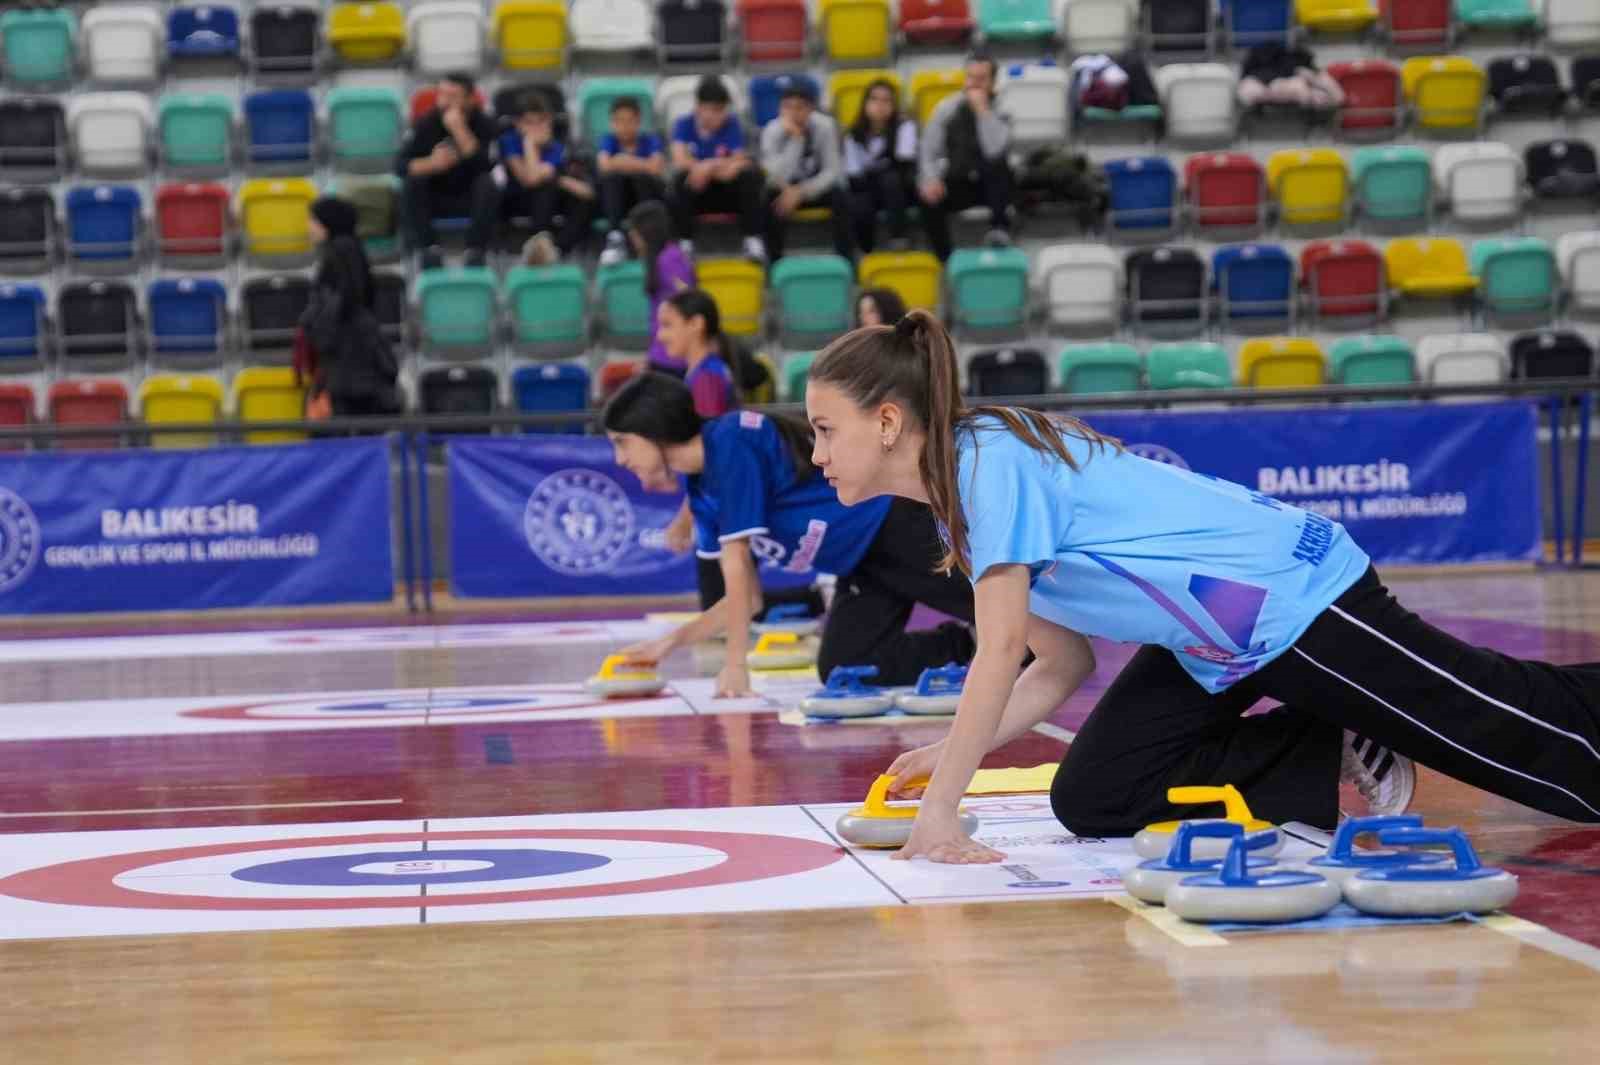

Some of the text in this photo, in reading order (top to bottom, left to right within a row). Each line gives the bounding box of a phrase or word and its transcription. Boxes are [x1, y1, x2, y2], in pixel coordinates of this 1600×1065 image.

[1257, 458, 1409, 495] BALIKESİR
[101, 500, 259, 538] BALIKESİR
[118, 544, 140, 565] VE
[142, 541, 187, 563] SPOR
